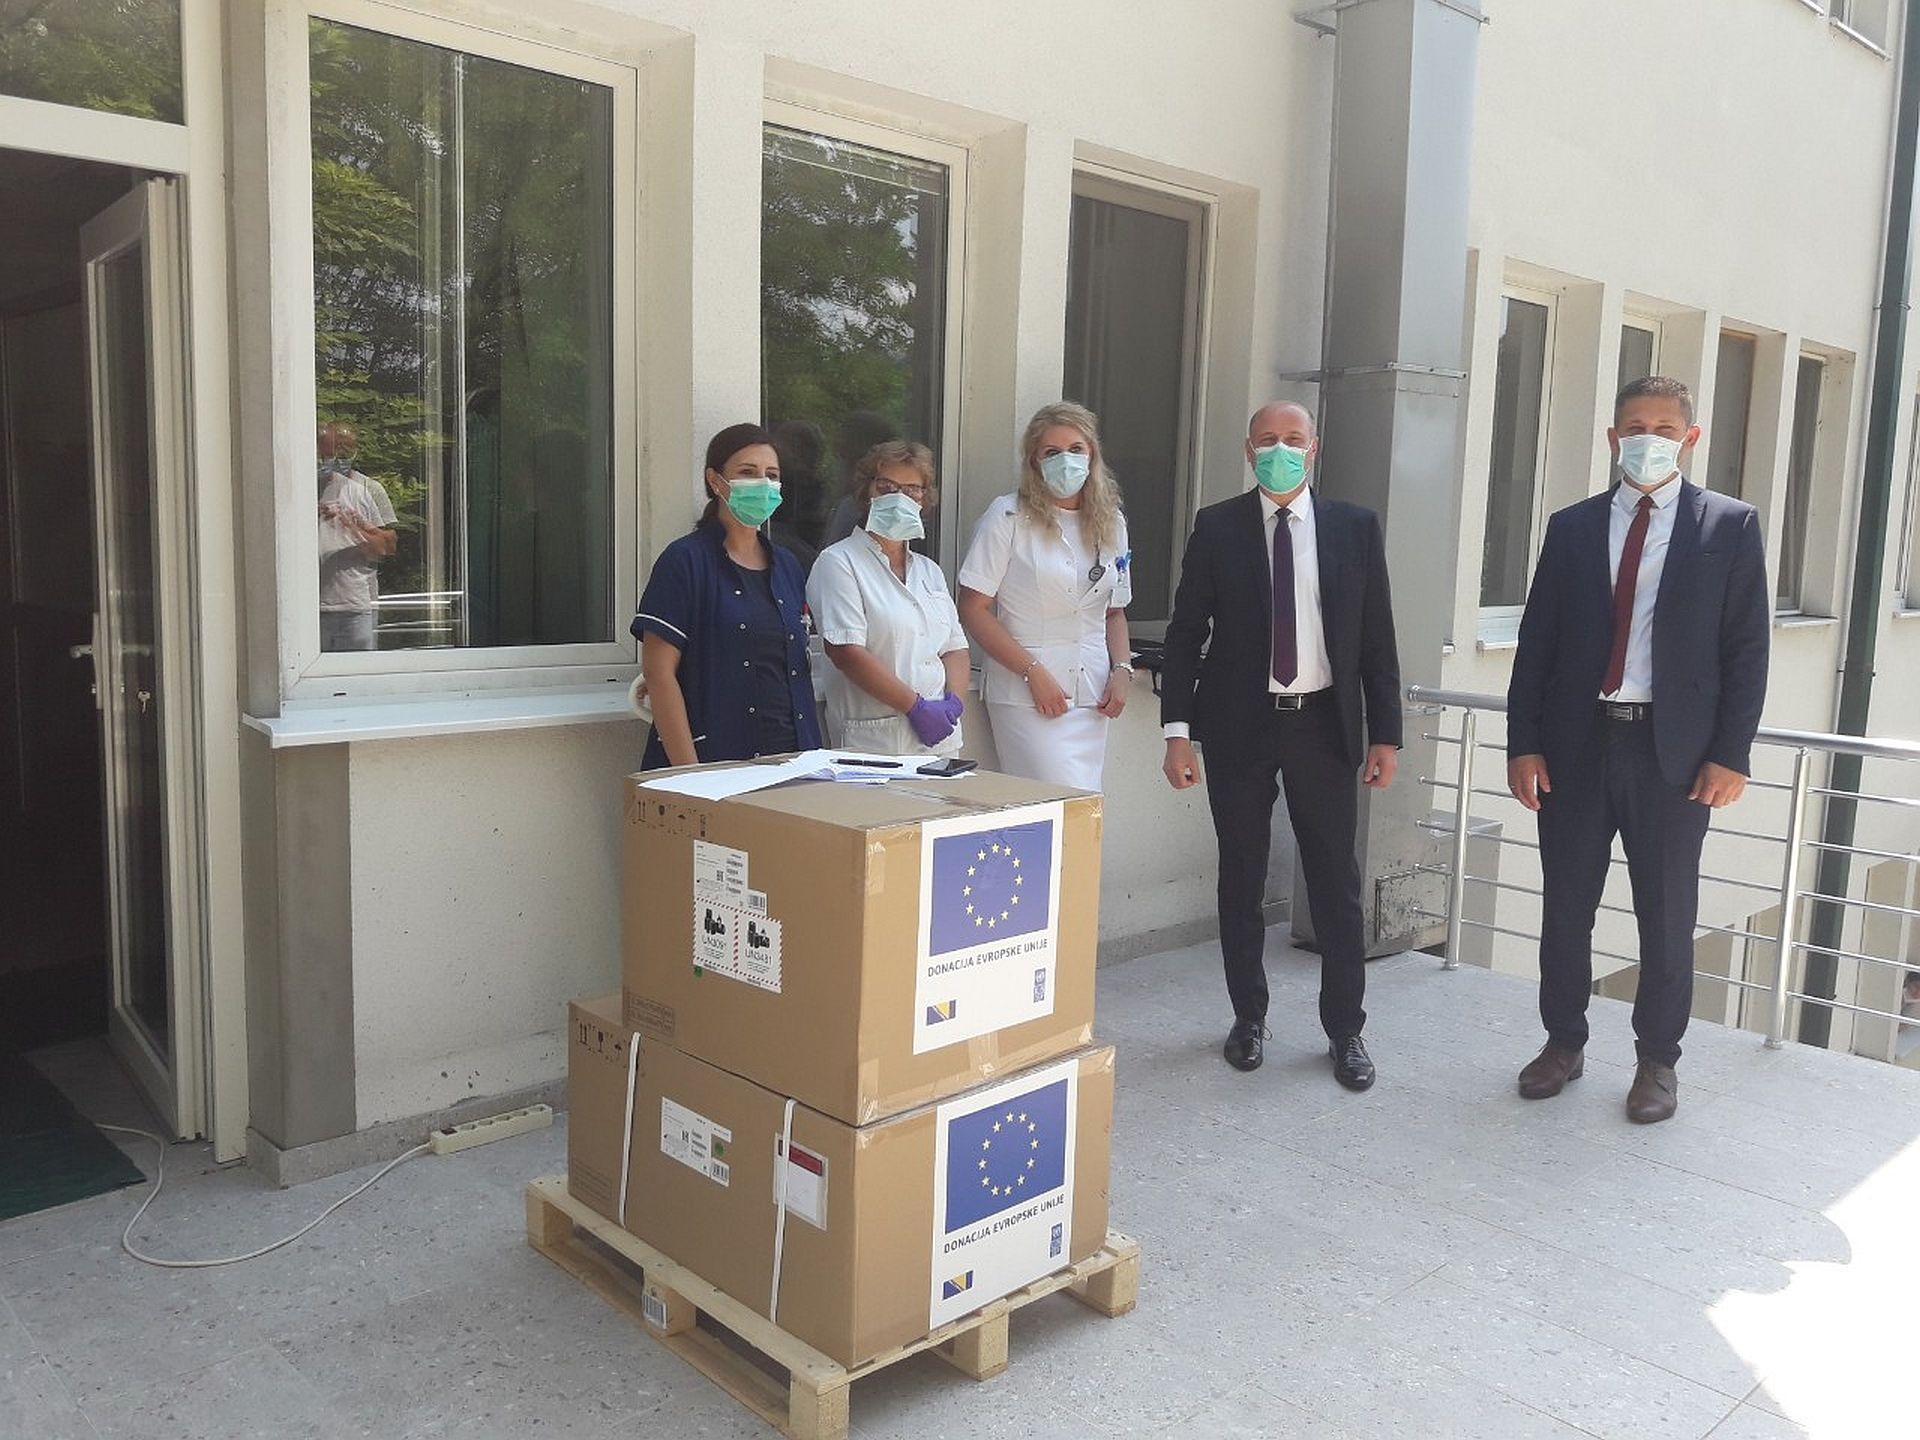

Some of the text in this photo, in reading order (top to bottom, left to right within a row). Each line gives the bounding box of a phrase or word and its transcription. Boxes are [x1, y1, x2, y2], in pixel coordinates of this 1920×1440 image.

[928, 938, 1048, 977] DONACIJA EVROPSKE UNIJE
[944, 1193, 1065, 1254] DONACIJA EVROPSKE UNIJE
